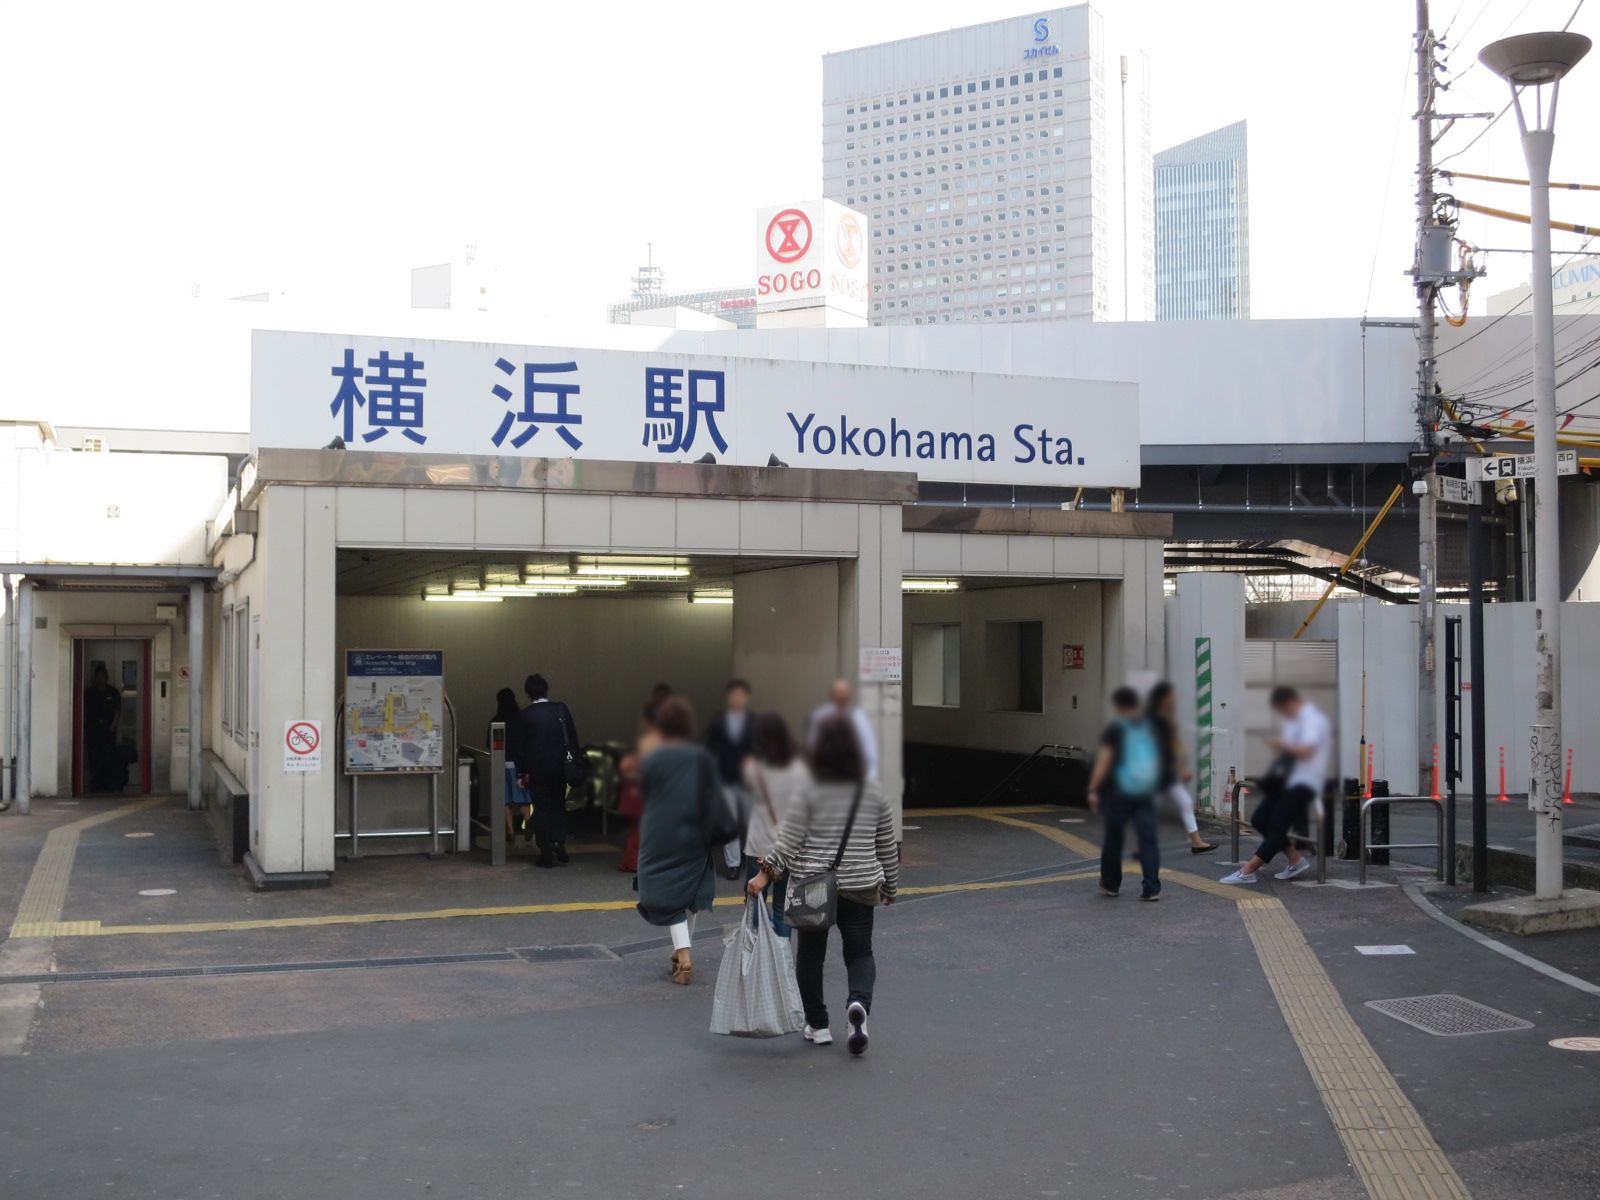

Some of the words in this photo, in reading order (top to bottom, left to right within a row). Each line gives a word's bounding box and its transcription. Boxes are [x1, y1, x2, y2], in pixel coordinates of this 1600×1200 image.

[758, 269, 821, 296] SOGO
[330, 348, 728, 456] 横浜駅
[786, 412, 996, 462] Yokohama
[1013, 423, 1086, 466] Sta.
